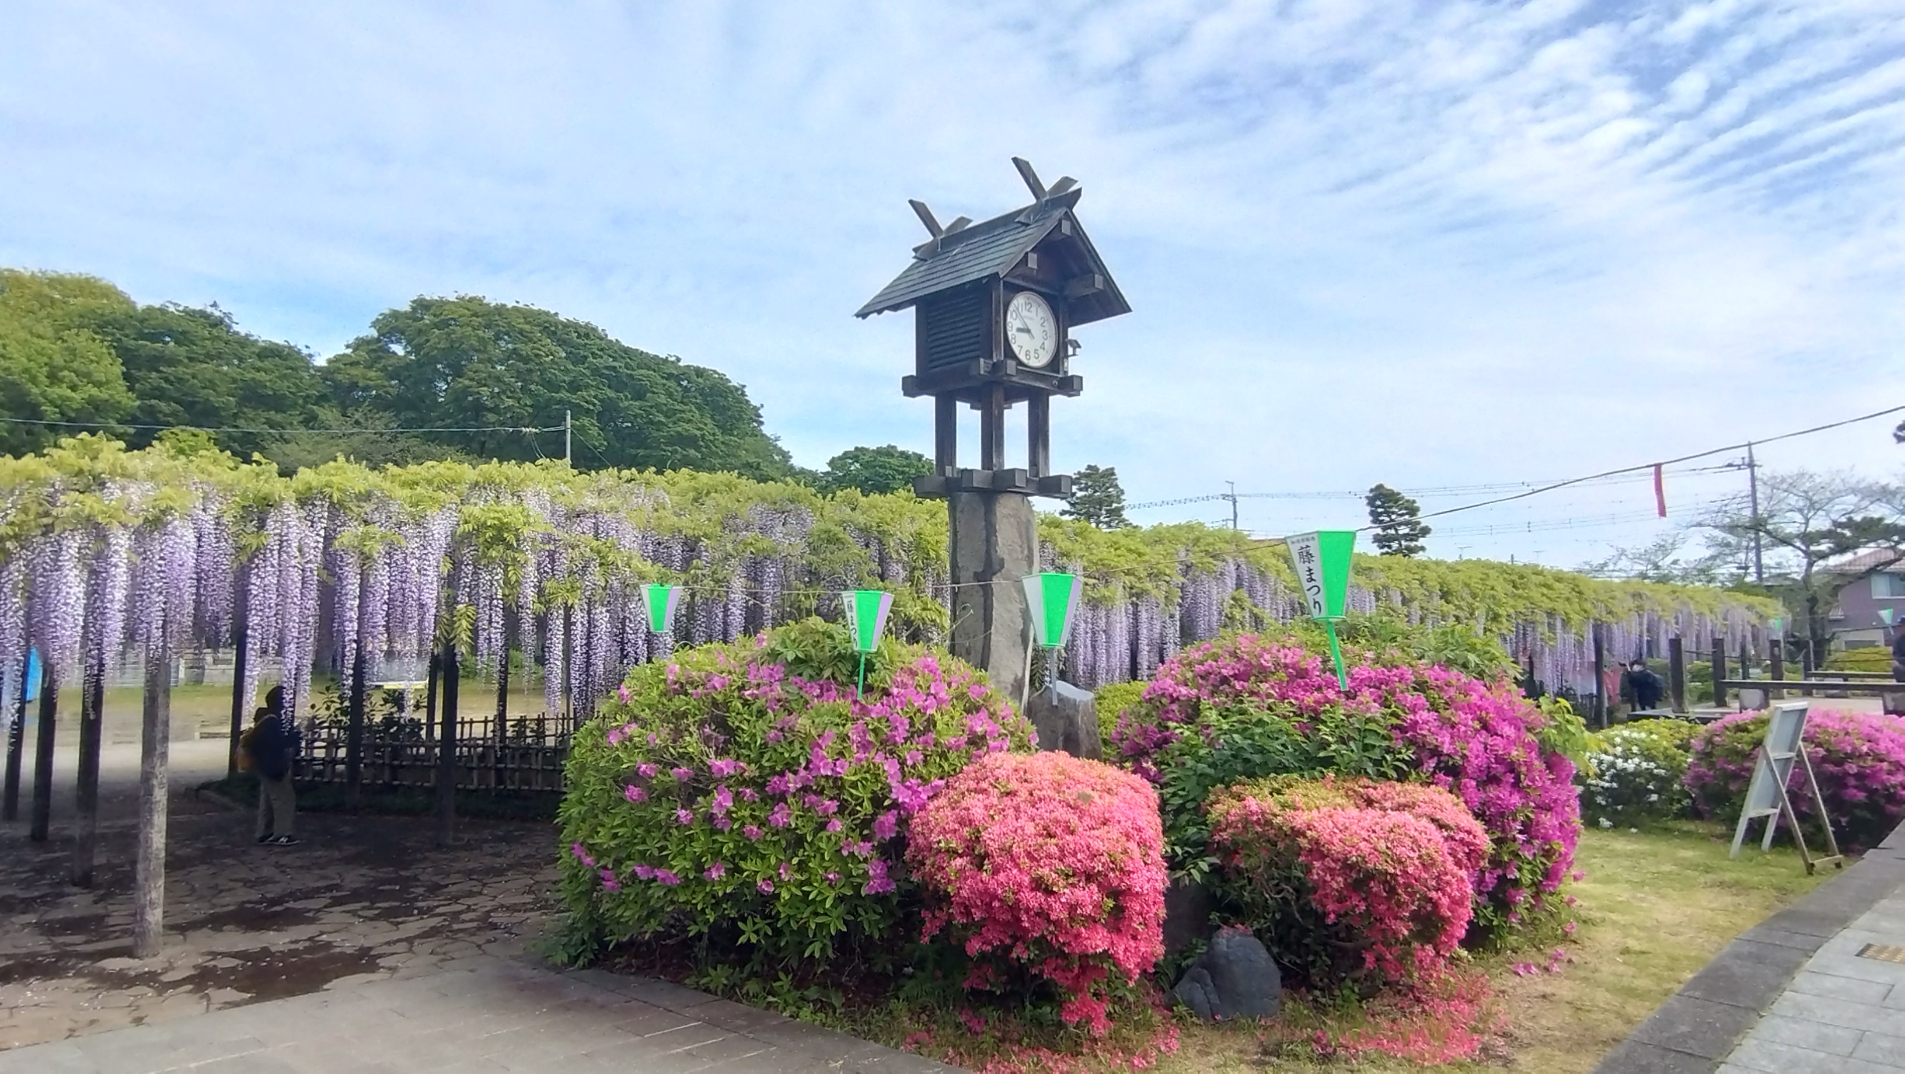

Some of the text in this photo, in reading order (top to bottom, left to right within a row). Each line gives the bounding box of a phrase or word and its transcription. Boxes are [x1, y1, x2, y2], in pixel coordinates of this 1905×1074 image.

[1024, 301, 1033, 313] 12
[1009, 308, 1018, 321] 10
[1006, 321, 1013, 332] 9
[1040, 316, 1046, 328] 2
[1010, 333, 1016, 345] 8
[1042, 329, 1048, 341] 3
[1017, 344, 1023, 355] 7
[1040, 341, 1046, 352] 4
[1025, 349, 1031, 361] 6
[1033, 348, 1040, 360] 5
[1298, 545, 1322, 616] 藤まつり
